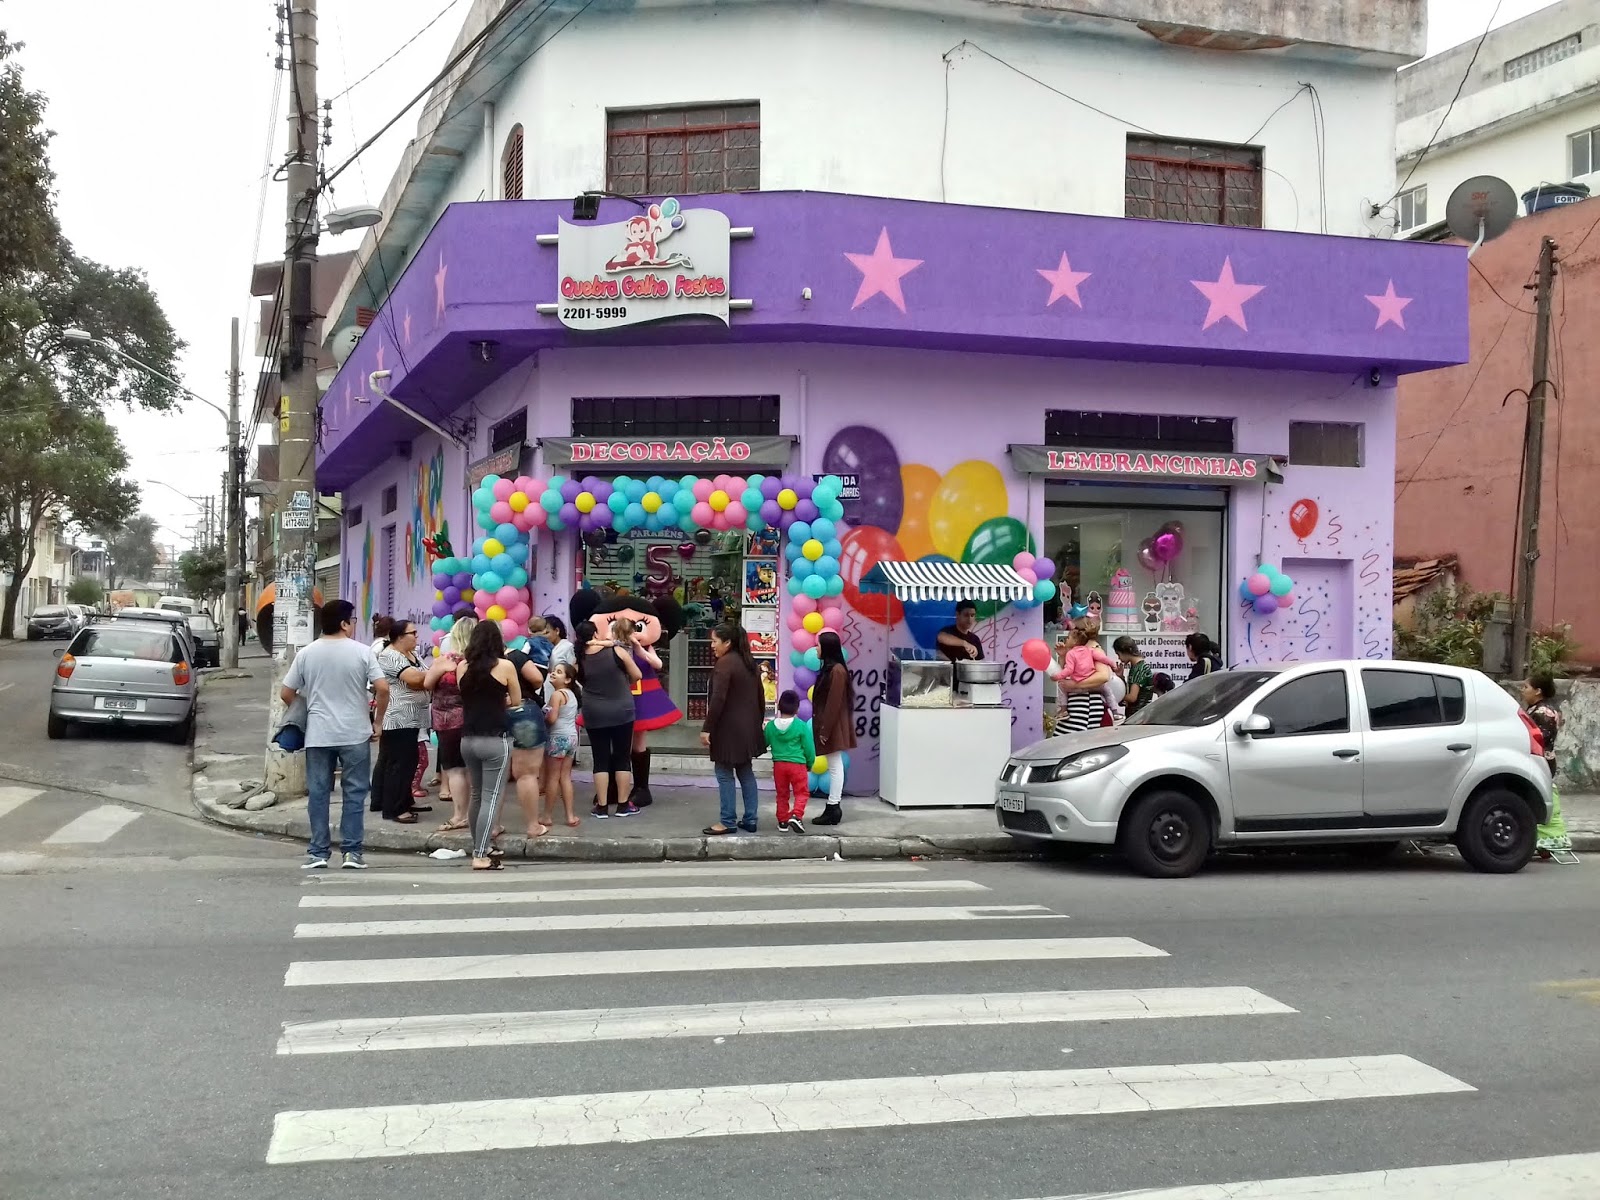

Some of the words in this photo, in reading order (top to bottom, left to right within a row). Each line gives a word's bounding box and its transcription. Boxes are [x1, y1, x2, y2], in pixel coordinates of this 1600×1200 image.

[560, 275, 619, 299] Quebra
[621, 273, 669, 299] Galho
[674, 275, 727, 298] Festas
[563, 306, 627, 320] 2201-5999
[570, 437, 751, 463] DECORAÇÃO
[1047, 451, 1257, 478] LEMBRANCINHAS
[630, 528, 684, 539] PARABÉNS
[1148, 638, 1156, 646] de
[1157, 638, 1187, 647] Decoraç
[1154, 650, 1163, 658] de
[1164, 650, 1186, 658] Festas
[1169, 663, 1194, 671] pronta
